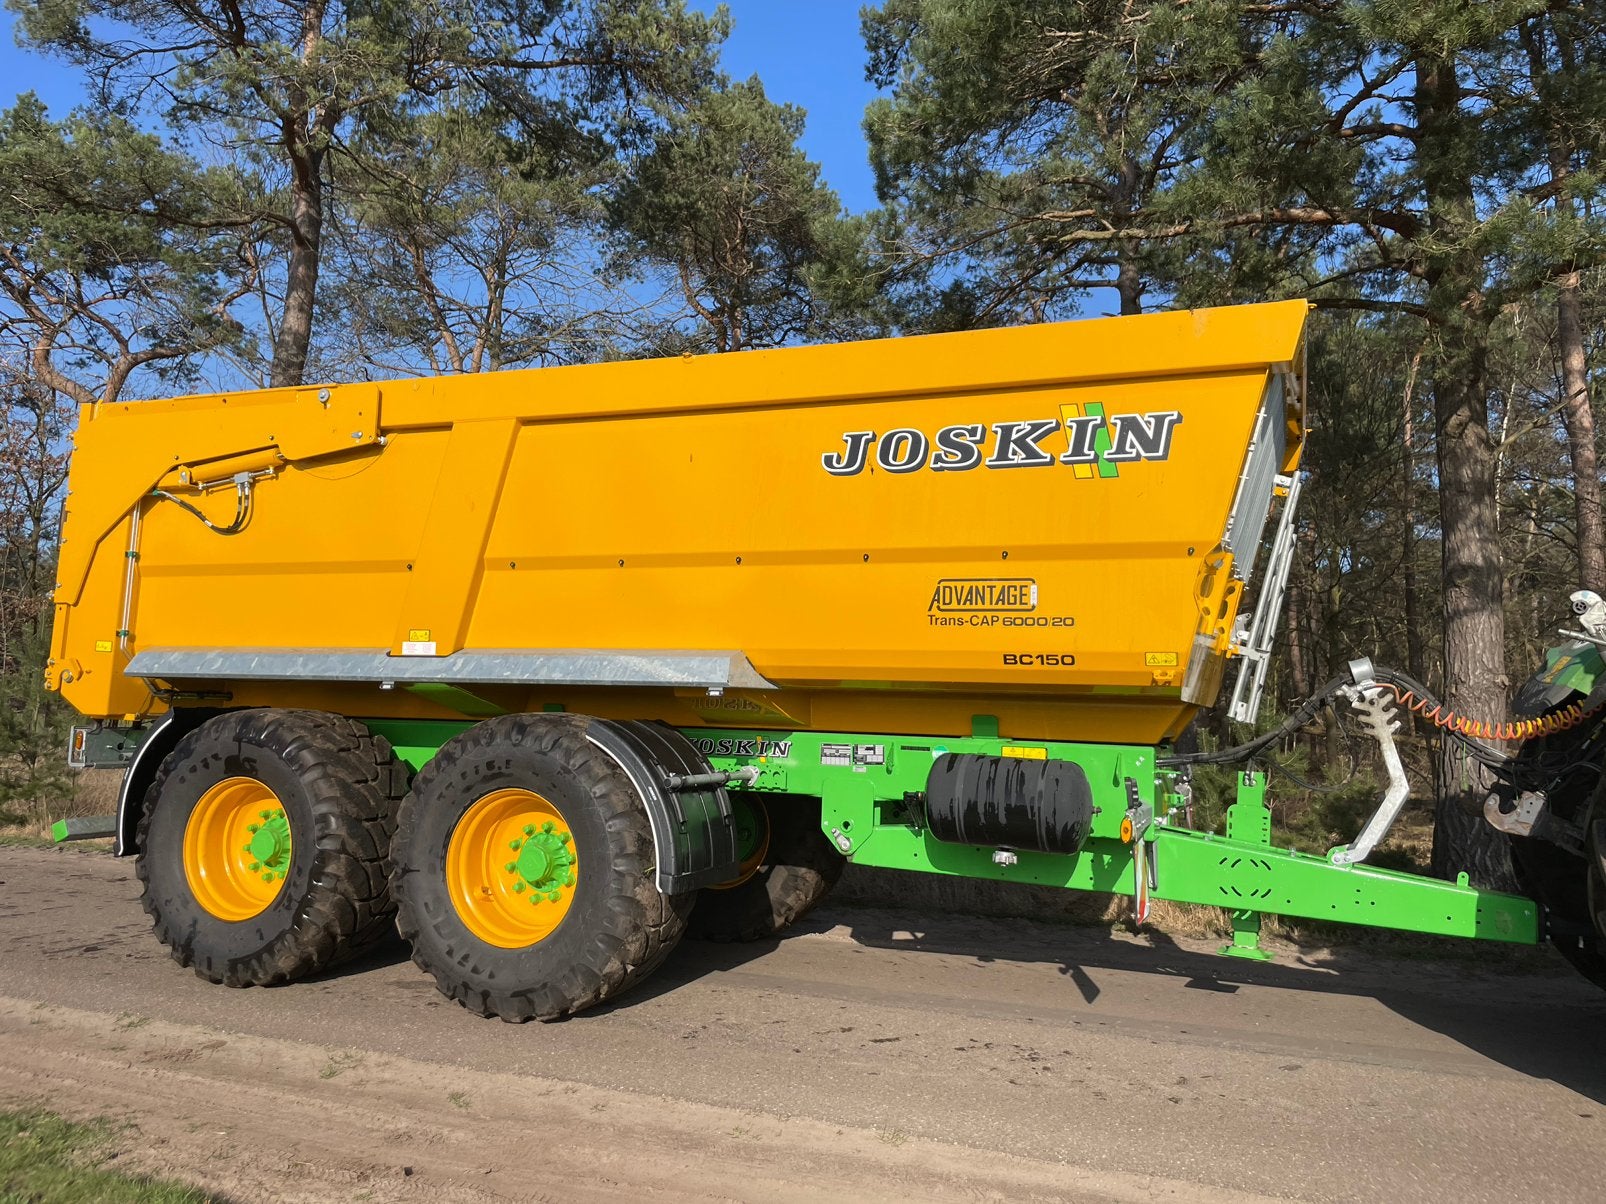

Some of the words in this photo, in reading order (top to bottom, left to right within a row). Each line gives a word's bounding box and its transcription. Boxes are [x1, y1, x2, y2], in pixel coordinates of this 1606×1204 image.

[821, 411, 1183, 476] JOSKIN
[928, 585, 1029, 612] ADVANTAGE
[927, 614, 1000, 627] Trans-CAP
[1002, 616, 1075, 627] 6000/20
[1002, 653, 1076, 666] BC150
